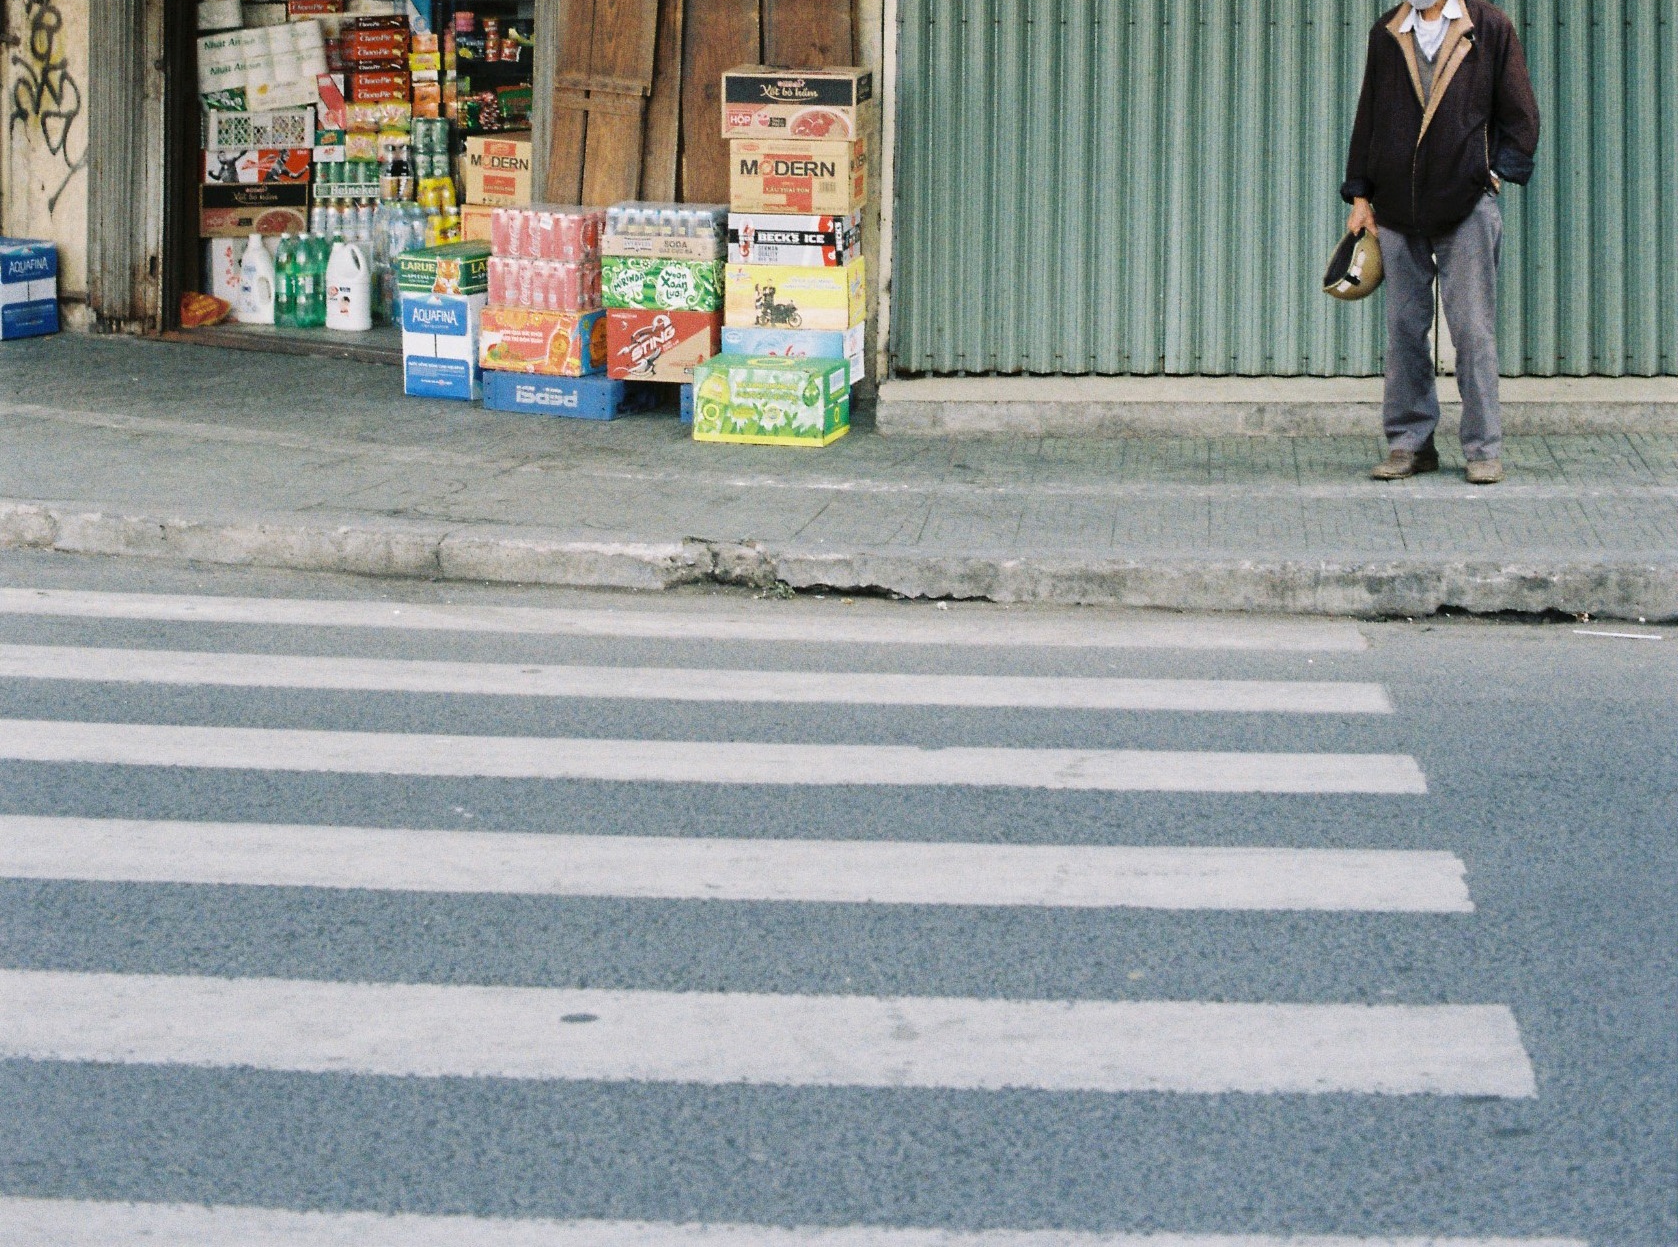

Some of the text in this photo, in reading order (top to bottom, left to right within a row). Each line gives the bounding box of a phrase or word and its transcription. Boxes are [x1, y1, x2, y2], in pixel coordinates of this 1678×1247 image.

[740, 159, 836, 177] MODERN
[757, 232, 825, 244] BECK'S ICE
[8, 256, 49, 276] AQUAFINA
[401, 261, 435, 272] LARUE
[412, 307, 458, 326] AQUAFINA
[631, 324, 676, 363] STING
